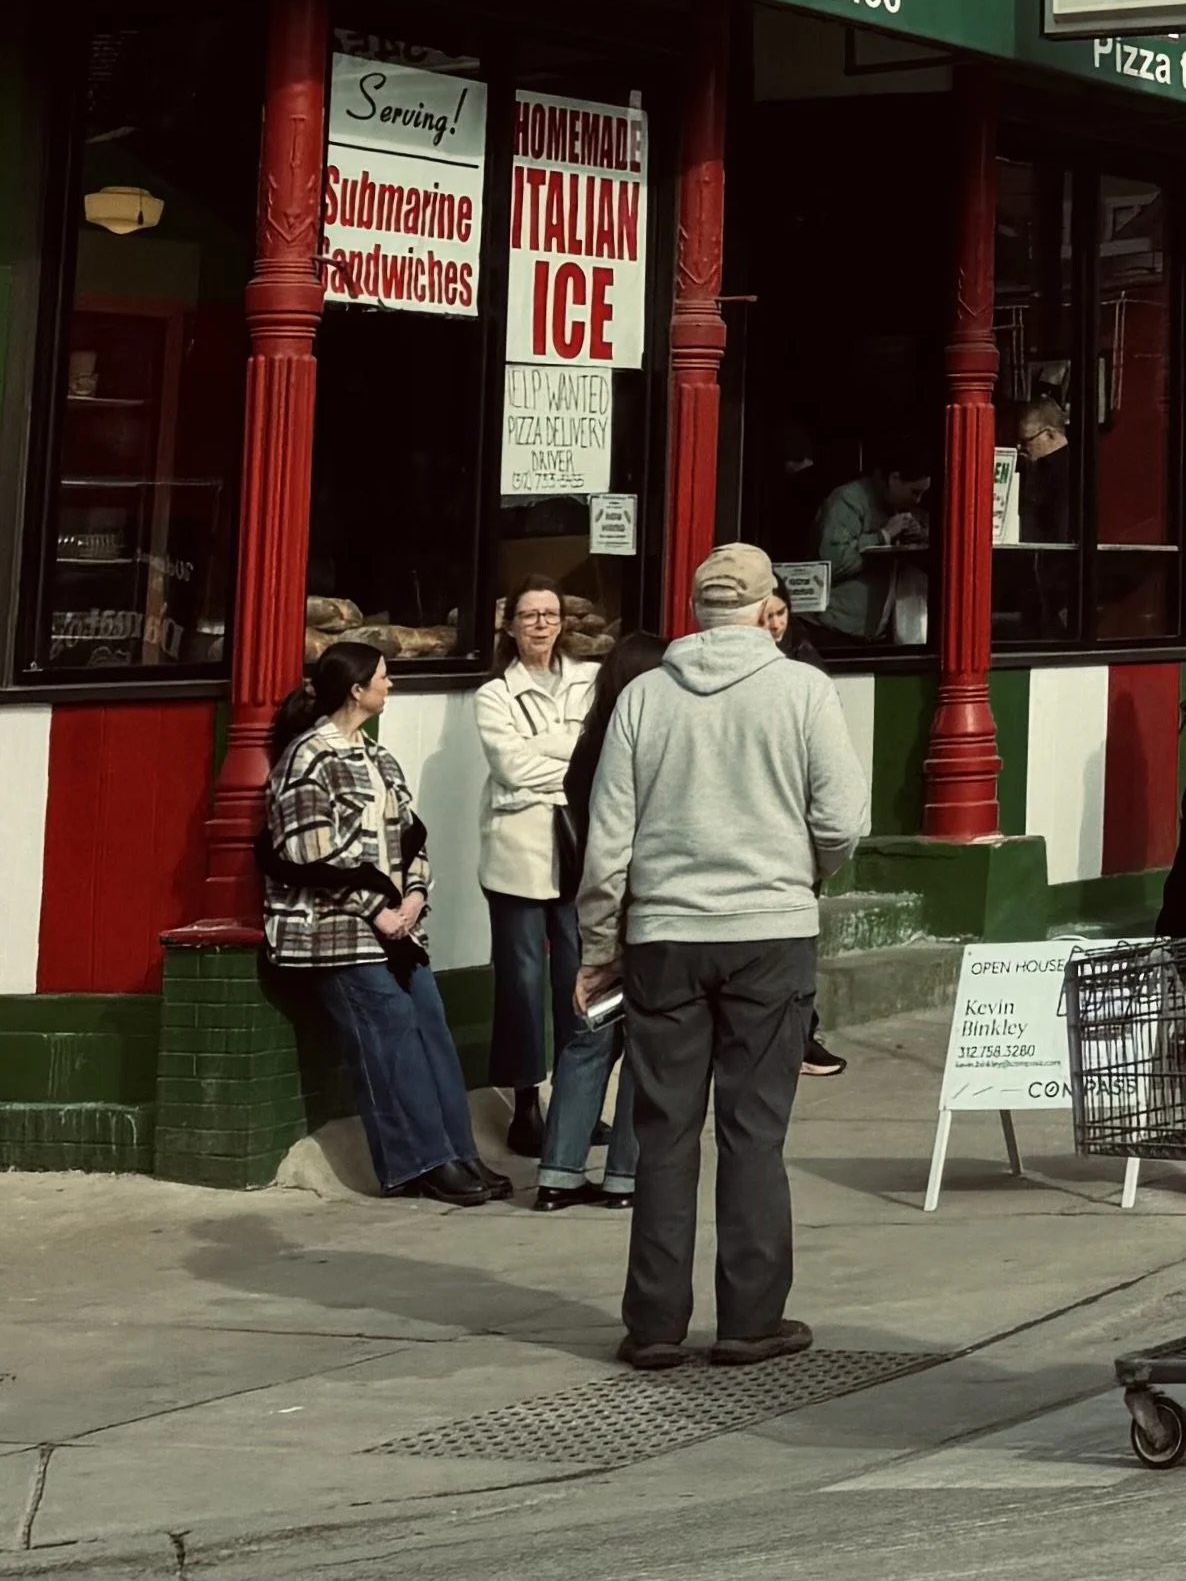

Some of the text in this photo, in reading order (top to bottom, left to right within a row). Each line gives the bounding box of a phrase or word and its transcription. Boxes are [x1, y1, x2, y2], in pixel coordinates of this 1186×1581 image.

[1093, 37, 1172, 85] Pizza
[345, 72, 469, 146] Serving!
[515, 101, 642, 174] HOMEMADE
[324, 165, 473, 243] Submarine
[512, 165, 640, 262] ITALIAN
[532, 260, 614, 361] ICE
[545, 372, 610, 415] WANTED
[508, 415, 609, 450] PIZZA DELIVERY
[531, 450, 576, 474] DRIVER
[971, 958, 1066, 975] OPEN HOUSE
[961, 1019, 1029, 1039] Binkley
[964, 998, 1015, 1016] Kevin
